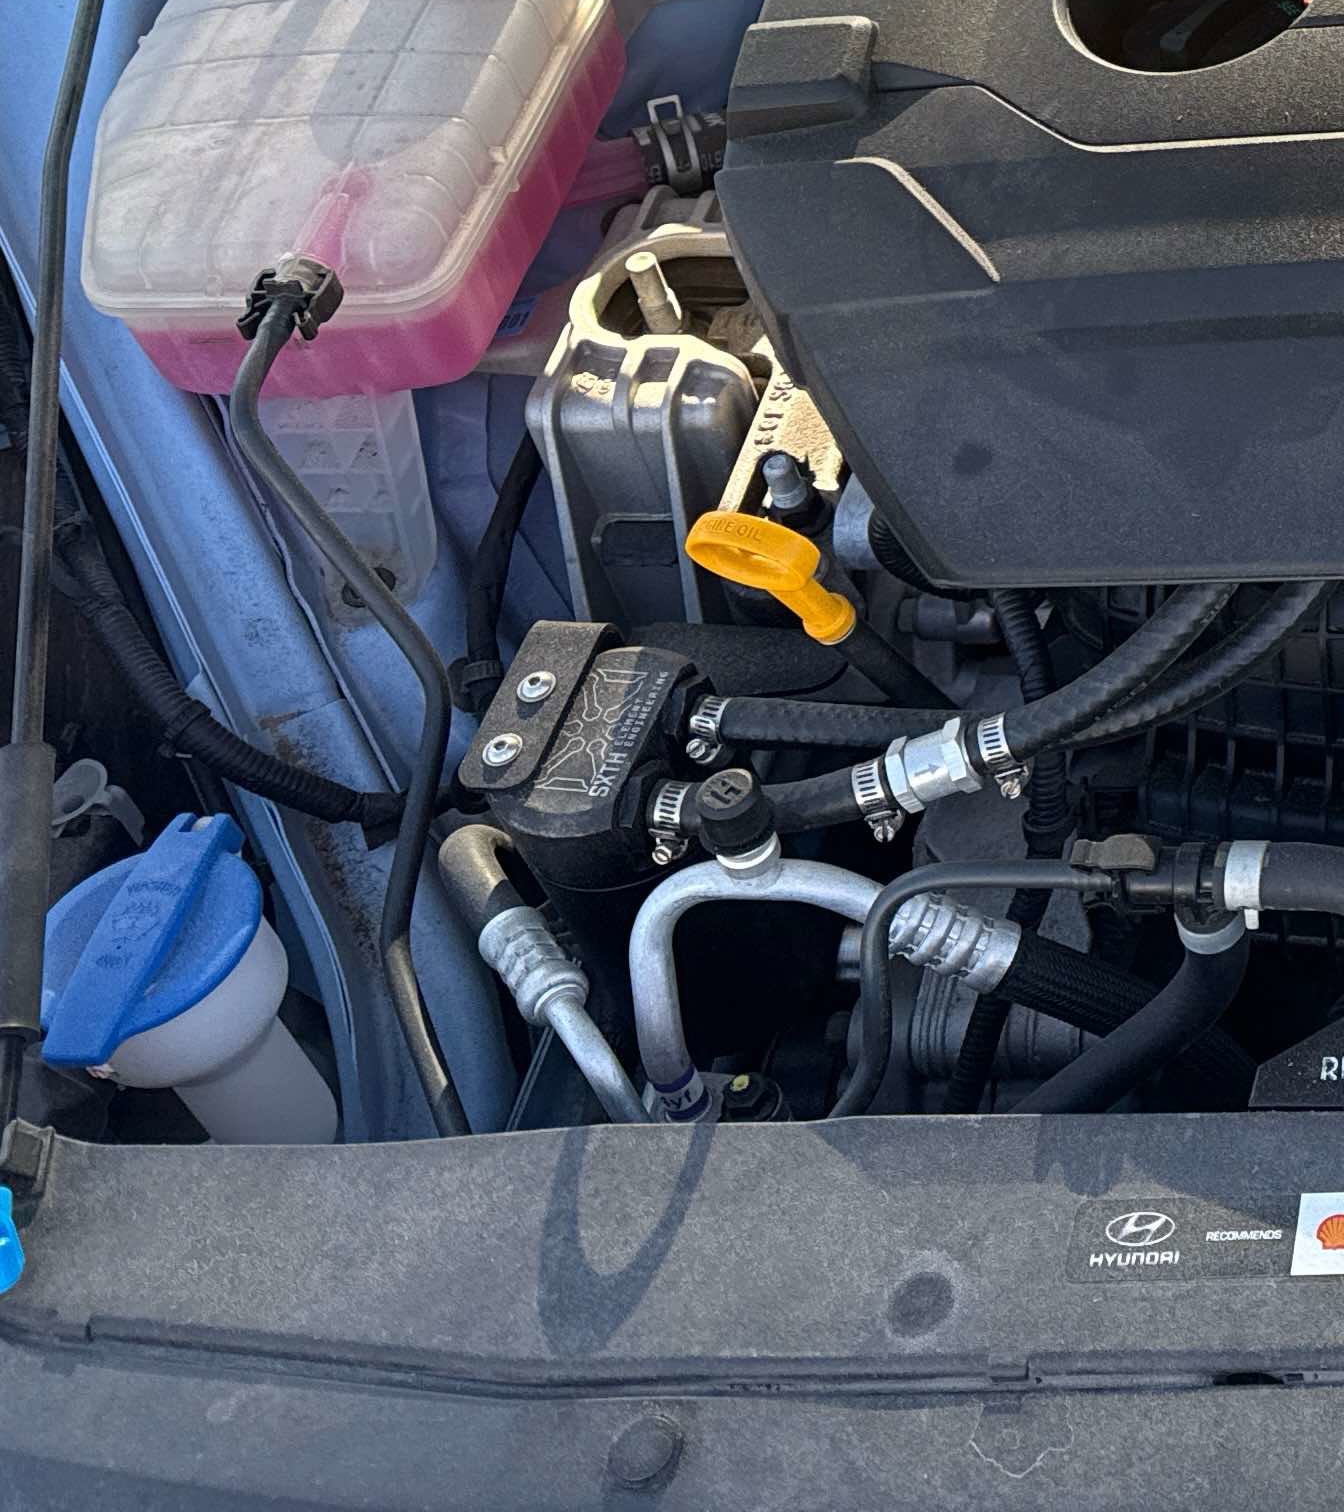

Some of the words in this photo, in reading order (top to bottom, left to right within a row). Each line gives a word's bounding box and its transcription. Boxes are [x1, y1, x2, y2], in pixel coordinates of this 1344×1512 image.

[736, 523, 762, 544] OIL
[623, 671, 669, 747] ENGINEERING
[588, 752, 628, 797] SXTH
[614, 698, 644, 747] ELEMENT
[1206, 1229, 1283, 1242] RECOMMENDS
[1089, 1251, 1180, 1267] HYUNDAI
